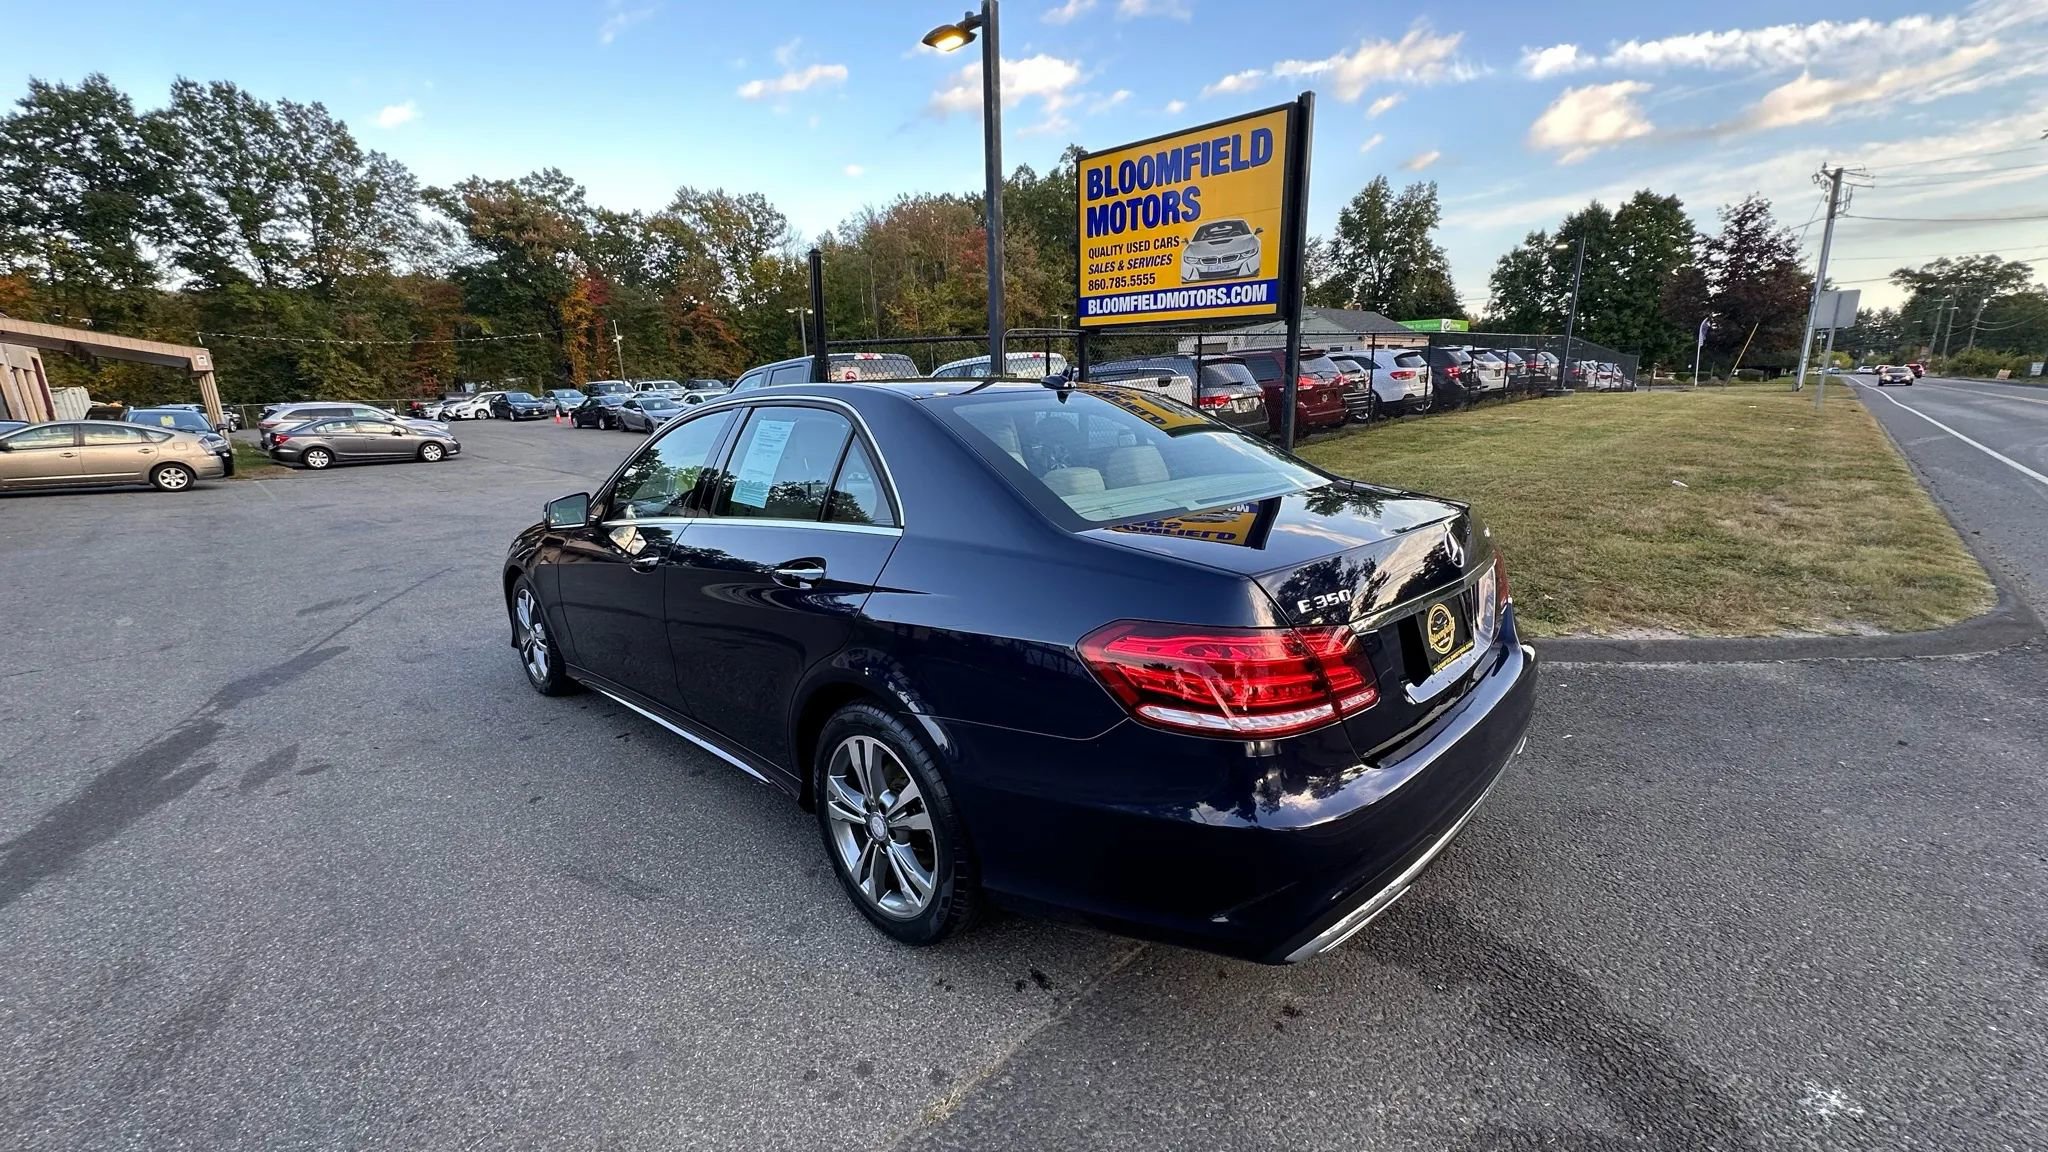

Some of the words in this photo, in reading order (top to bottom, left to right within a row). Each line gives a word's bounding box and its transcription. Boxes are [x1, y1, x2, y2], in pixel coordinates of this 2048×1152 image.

[1087, 127, 1274, 202] BLOOMFIELD
[1087, 186, 1201, 238] MOTORS
[1088, 244, 1124, 259] QUALITY
[1126, 239, 1150, 254] USED
[1153, 235, 1180, 250] CARS
[1088, 261, 1116, 275] SALES
[1117, 260, 1125, 271] &
[1126, 253, 1173, 270] SERVICES
[1088, 272, 1156, 291] 860.785.5555
[1088, 283, 1267, 315] BLOOMFIELDMOTORS.COM
[1297, 599, 1313, 614] E
[1313, 589, 1351, 609] 350
